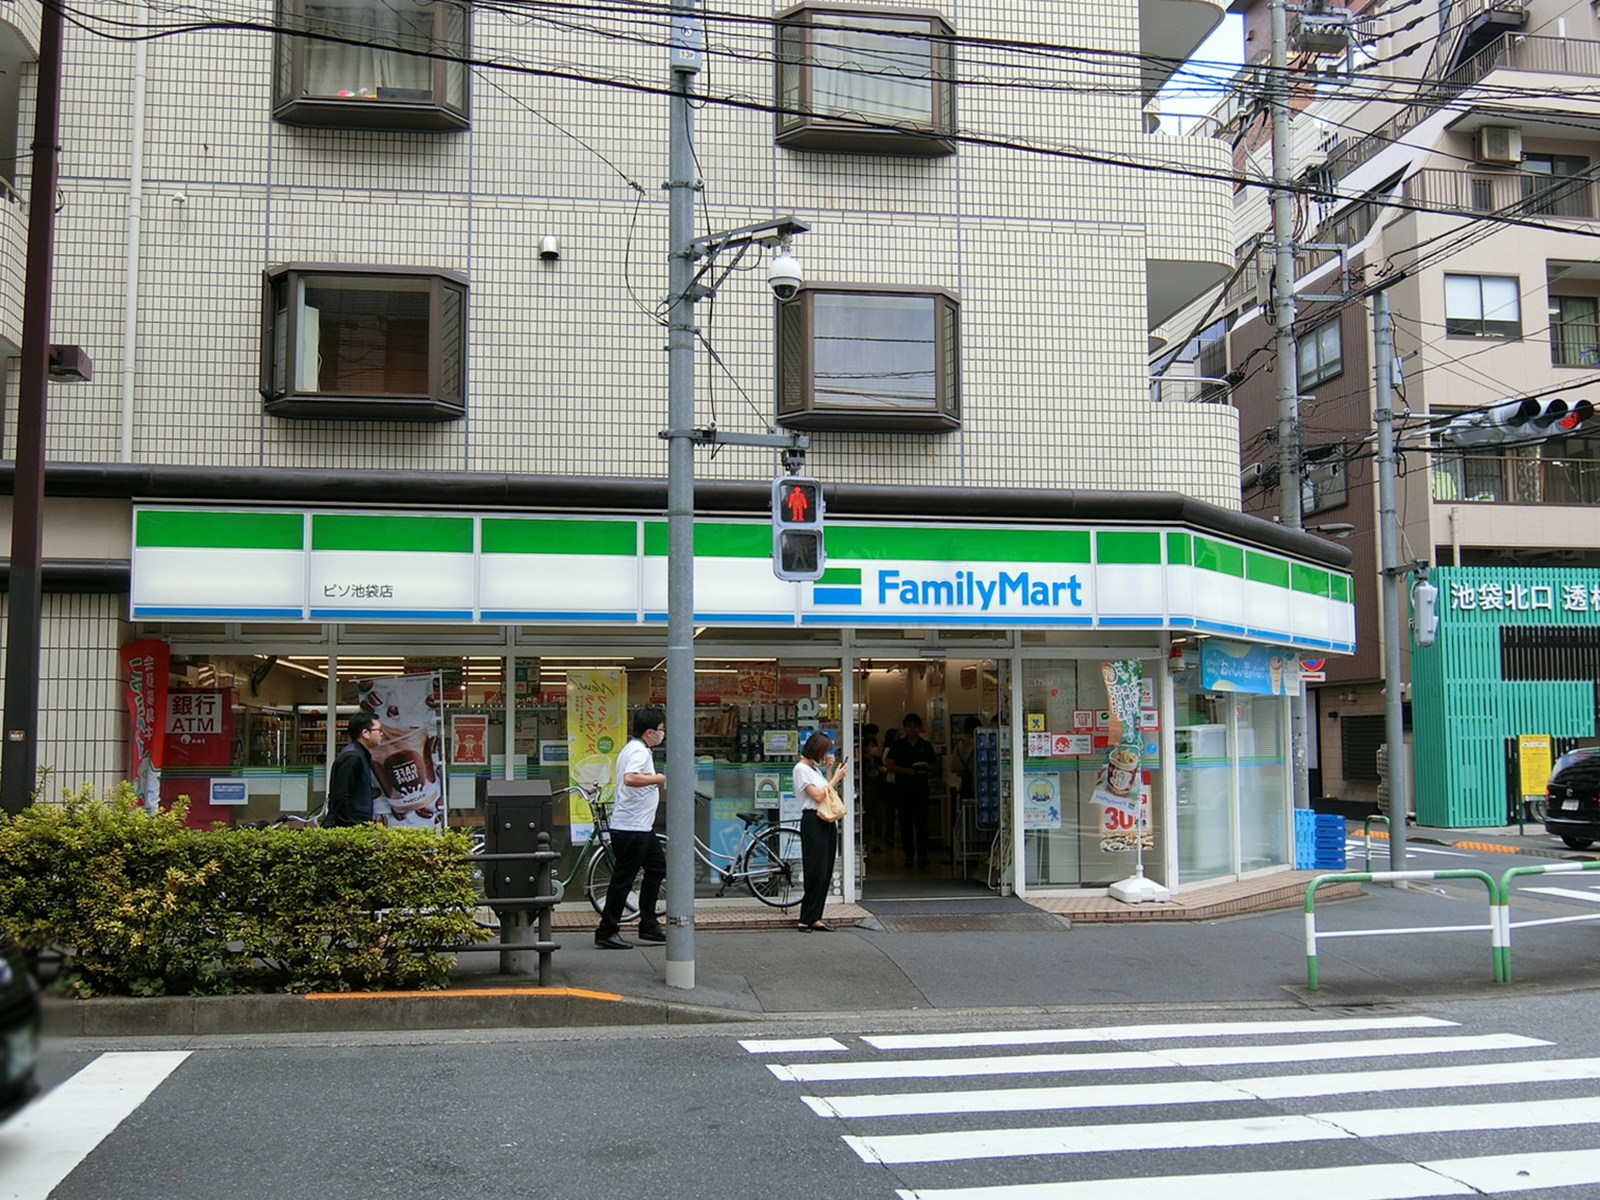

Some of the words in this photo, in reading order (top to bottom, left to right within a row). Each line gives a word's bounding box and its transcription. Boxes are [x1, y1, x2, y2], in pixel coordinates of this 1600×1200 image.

[878, 569, 1082, 610] FamilyMart
[1451, 583, 1552, 611] 池袋北口
[172, 696, 216, 715] 銀行
[171, 718, 214, 732] ATM
